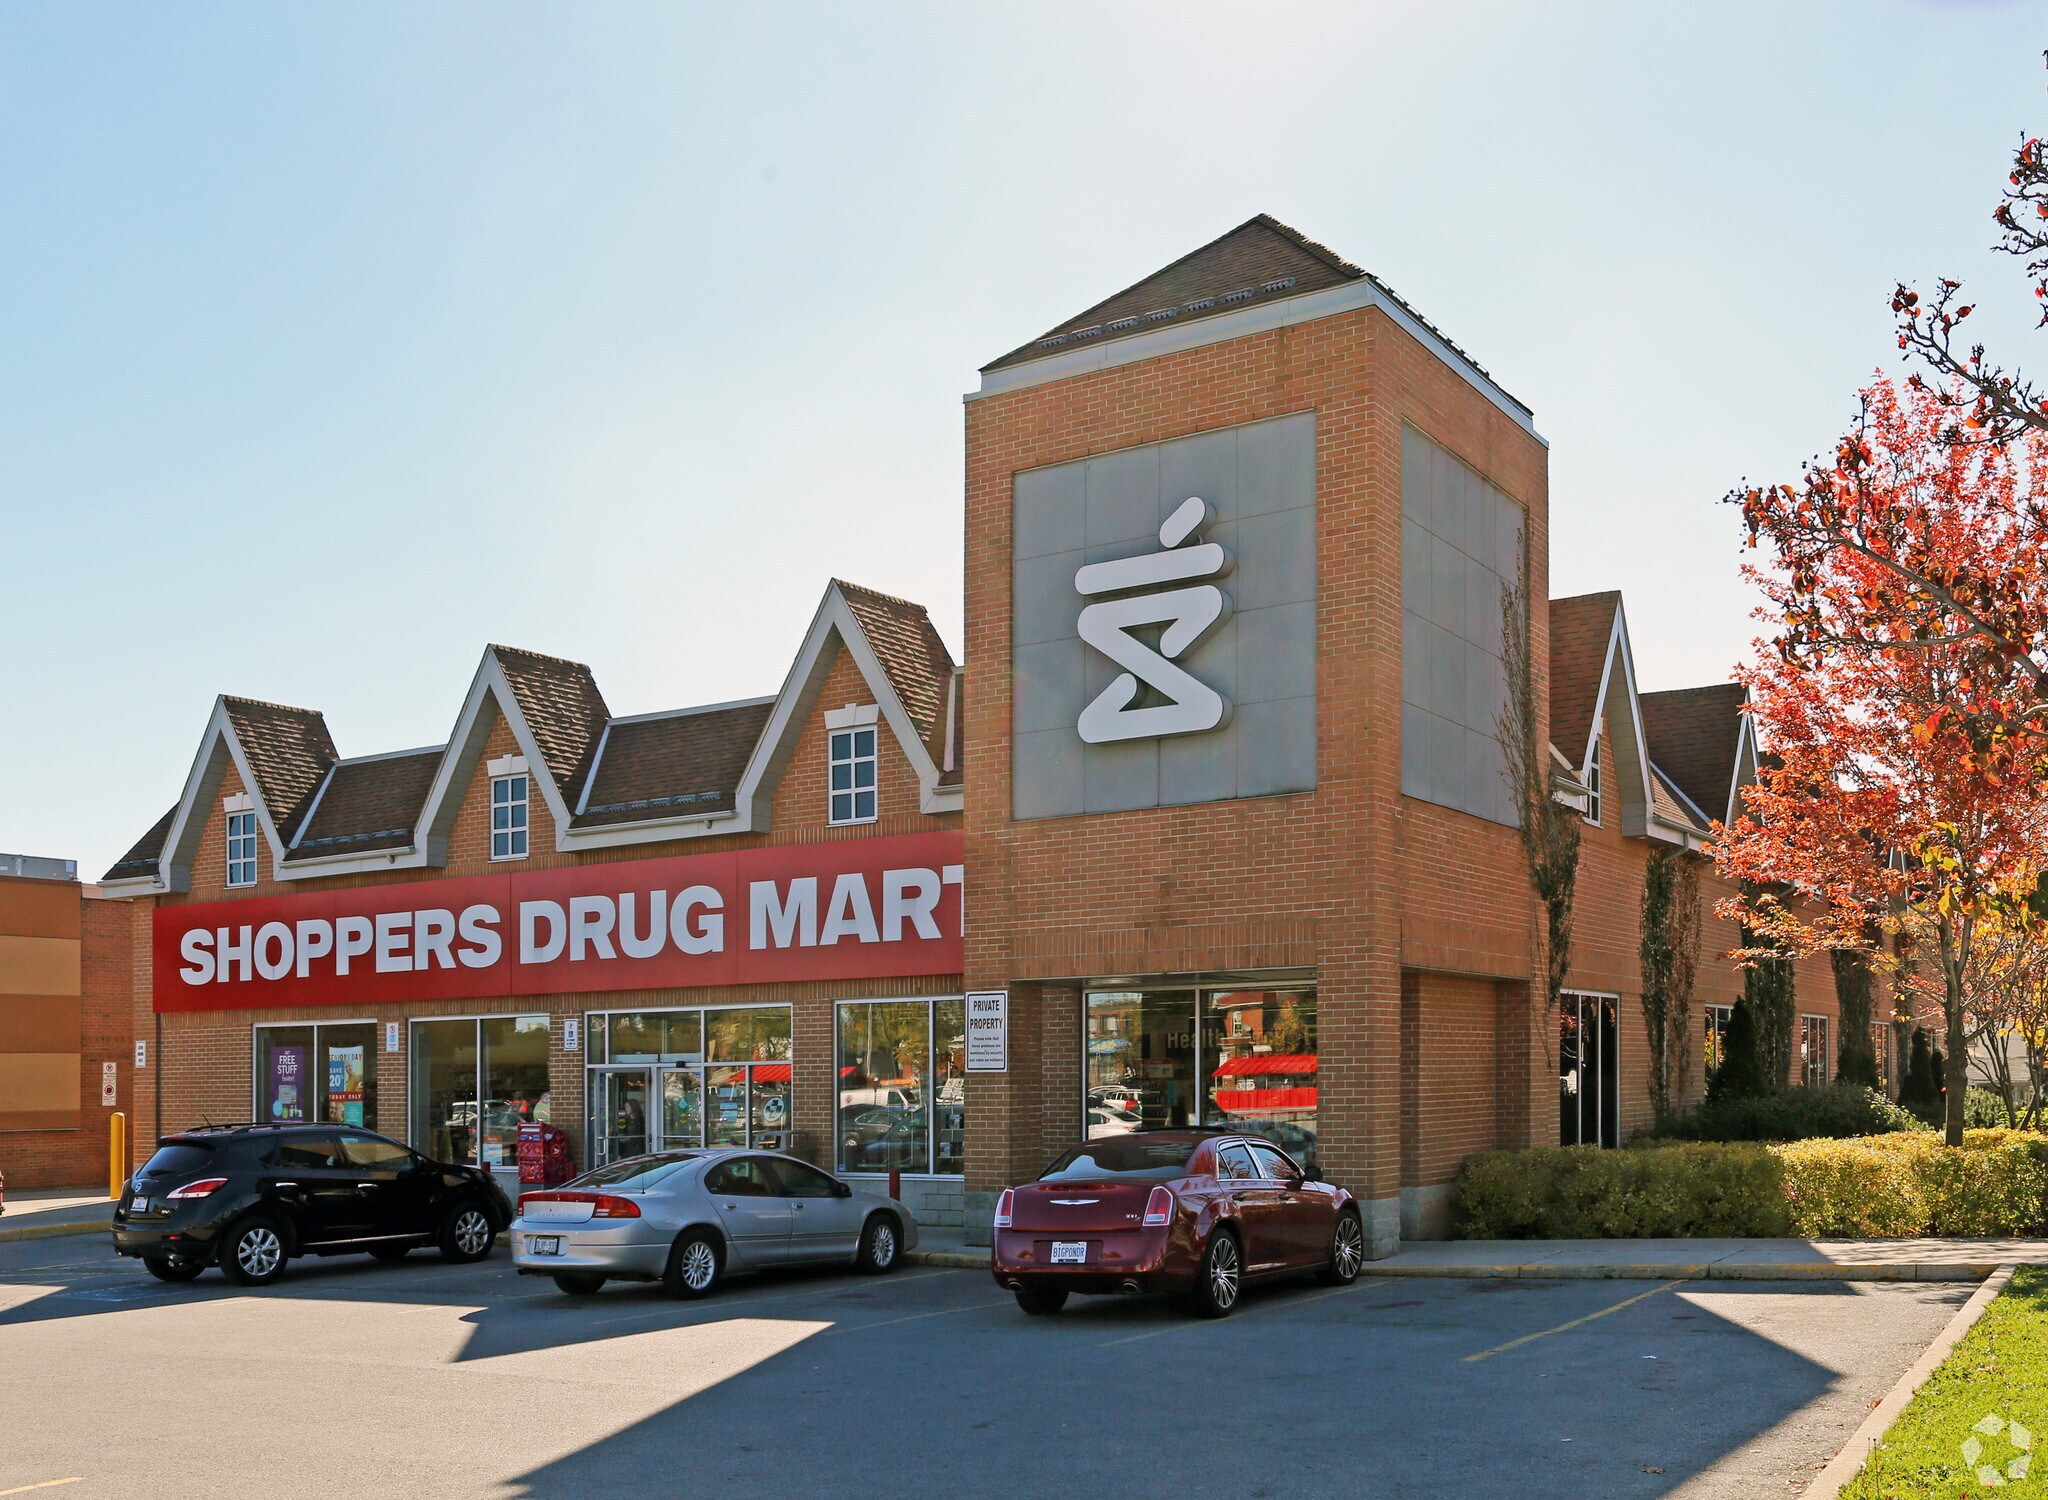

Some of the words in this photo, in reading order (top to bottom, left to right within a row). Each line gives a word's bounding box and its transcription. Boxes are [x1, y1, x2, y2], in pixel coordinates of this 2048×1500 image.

[180, 904, 502, 986] SHOPPERS
[519, 886, 724, 965] DRUG
[974, 1000, 999, 1011] PRIVATE
[970, 1018, 1003, 1029] PROPERTY
[280, 1056, 296, 1064] FREE
[351, 1053, 363, 1061] DAY
[278, 1065, 298, 1074] STUFF
